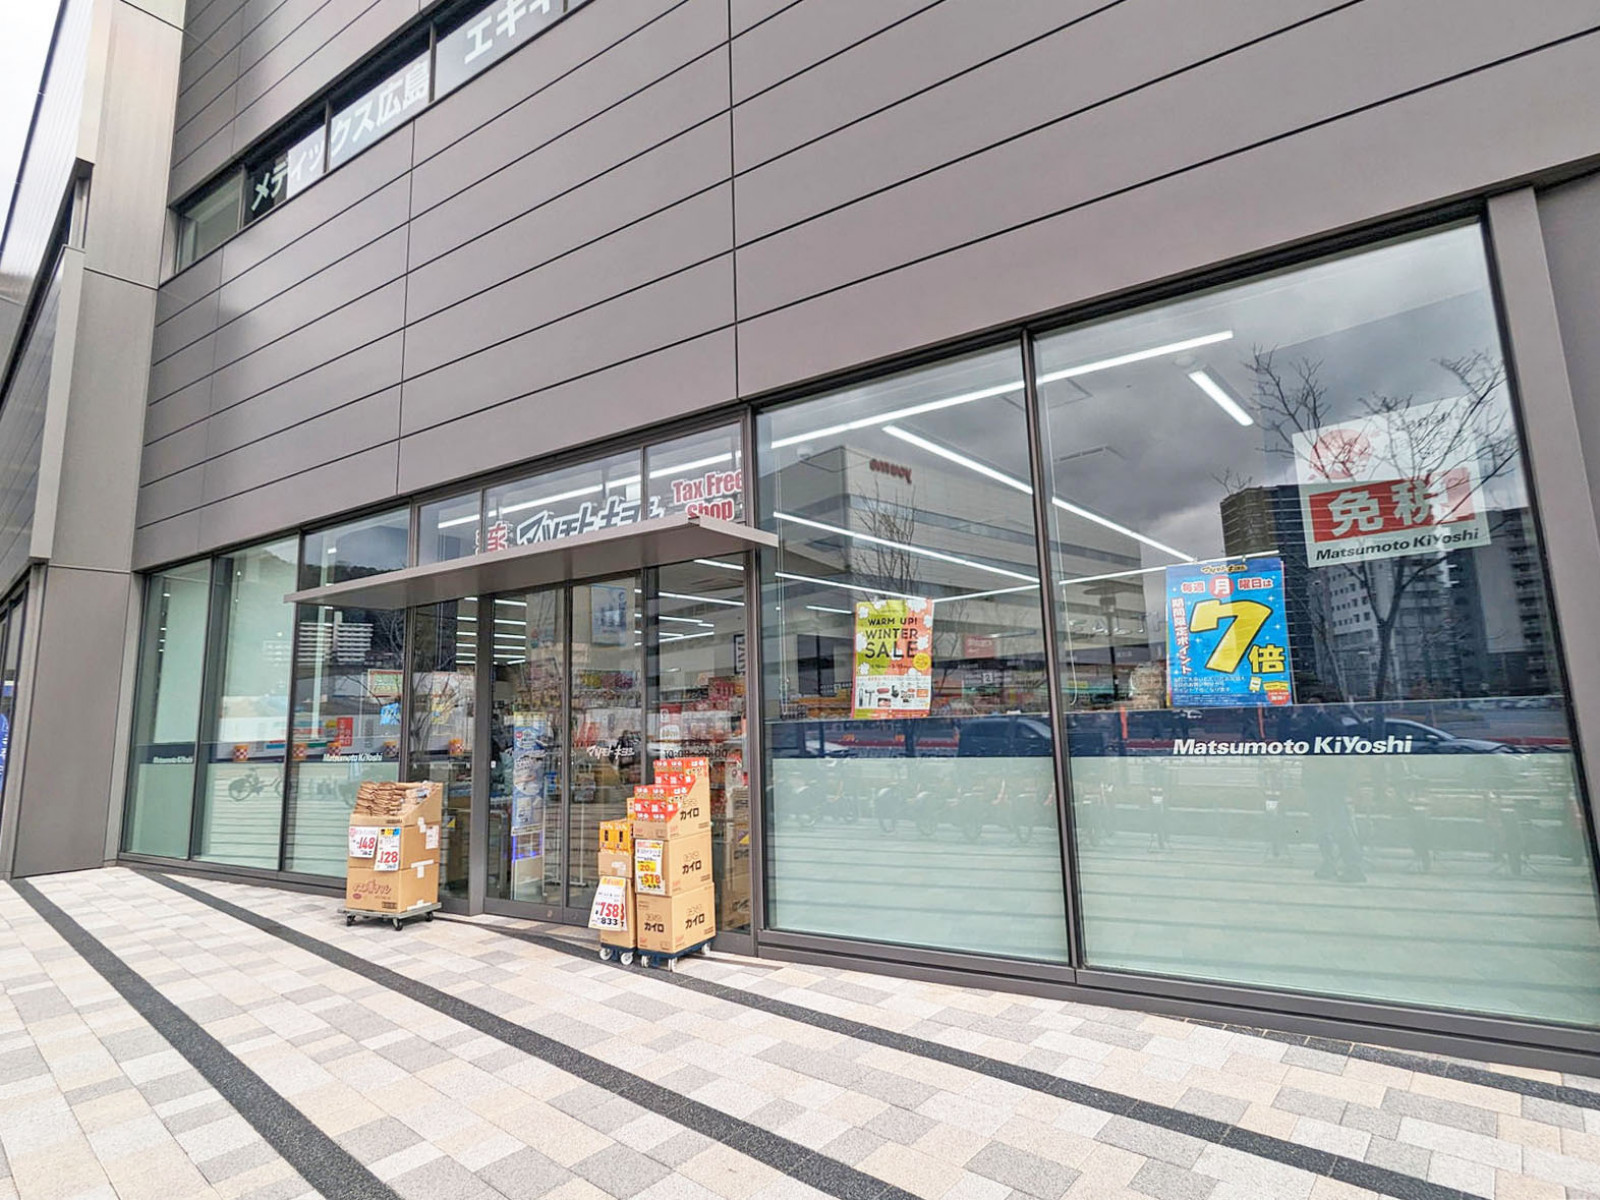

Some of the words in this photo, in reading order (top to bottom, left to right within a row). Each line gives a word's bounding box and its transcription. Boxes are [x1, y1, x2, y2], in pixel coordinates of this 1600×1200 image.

[673, 479, 703, 503] Tax
[706, 469, 742, 497] Free
[686, 499, 733, 523] Shop
[1315, 541, 1410, 561] Matsumoto
[1413, 528, 1480, 548] KiYoshi
[867, 618, 895, 626] WARM
[900, 617, 918, 625] UP!
[865, 628, 918, 639] WINTER
[865, 641, 918, 658] SALE
[1173, 739, 1309, 755] Matsumoto
[1314, 735, 1412, 754] KiYoshi
[679, 808, 700, 821] カイロ
[359, 837, 375, 849] 148
[380, 851, 398, 863] 128
[682, 860, 702, 875] カイロ
[600, 901, 619, 918] 758
[644, 923, 664, 933] カイロ
[685, 914, 705, 929] カイロ
